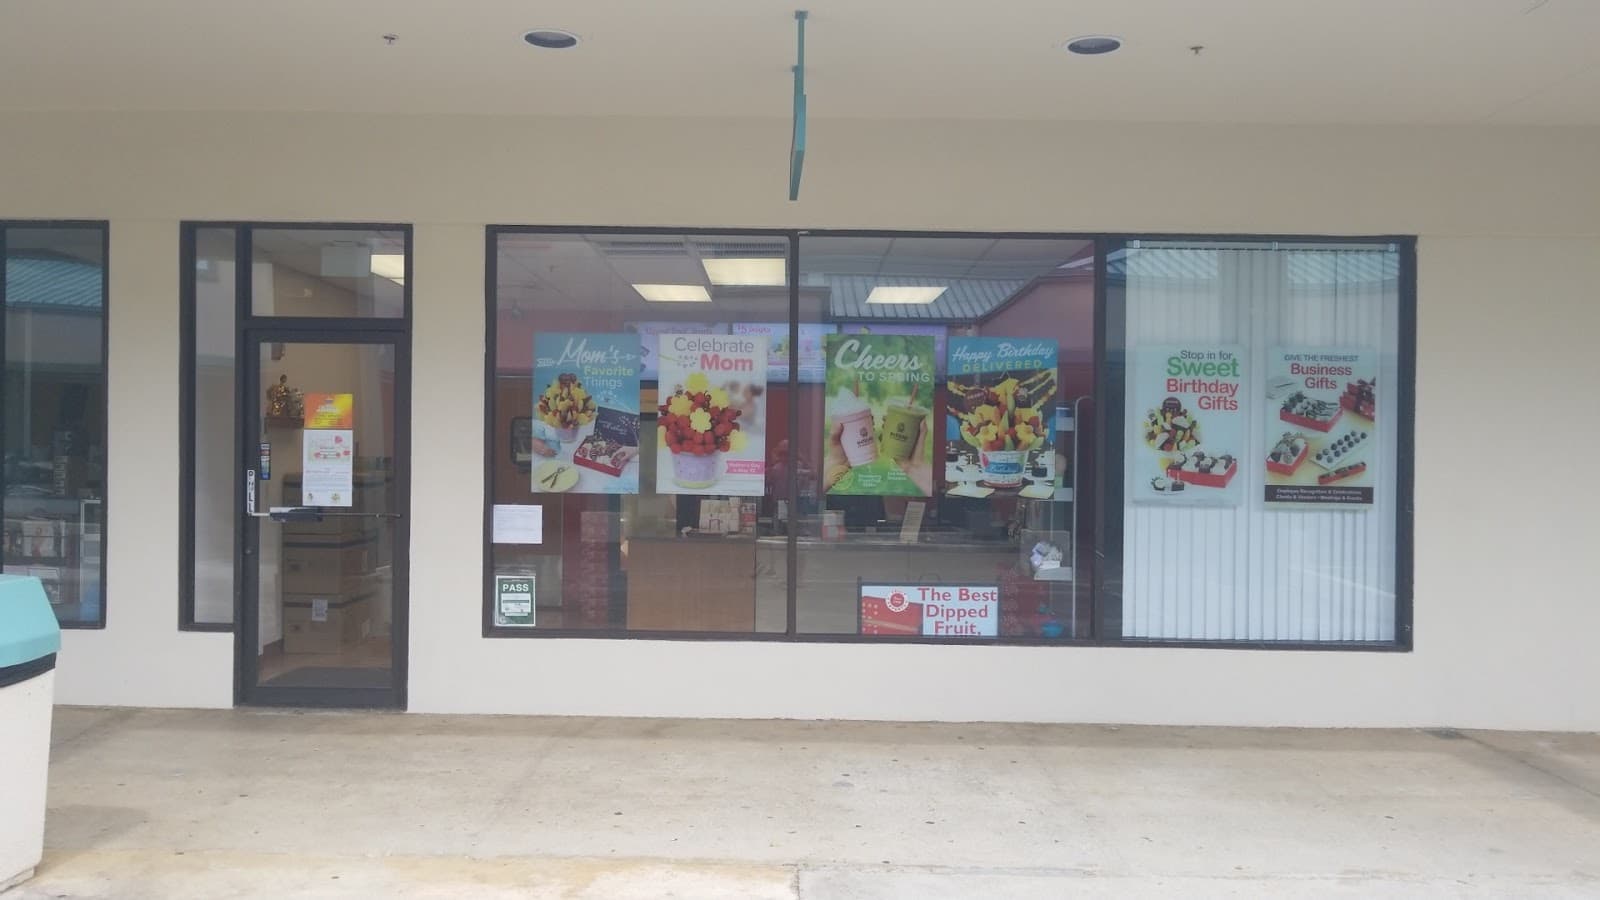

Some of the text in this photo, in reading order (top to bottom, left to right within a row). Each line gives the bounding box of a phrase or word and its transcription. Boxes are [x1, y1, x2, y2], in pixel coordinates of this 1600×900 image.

[674, 337, 754, 353] Celebrate
[557, 337, 620, 368] Mom's
[834, 339, 921, 371] Cheers
[952, 343, 1055, 363] Happy Birthday
[1180, 350, 1232, 362] Stop in for
[700, 354, 754, 371] Mom
[963, 360, 1042, 373] DELIVERED
[1167, 356, 1240, 377] Sweet
[1290, 363, 1352, 376] Business
[584, 366, 634, 376] Favorite
[860, 371, 930, 382] TO SPRING
[584, 376, 622, 389] Things
[1167, 378, 1238, 397] Birthday
[1304, 376, 1337, 389] Gifts
[1198, 396, 1238, 410] Gifts
[502, 584, 529, 592] PASS
[918, 588, 951, 601] The
[958, 588, 998, 602] Best
[926, 605, 988, 622] Dipped
